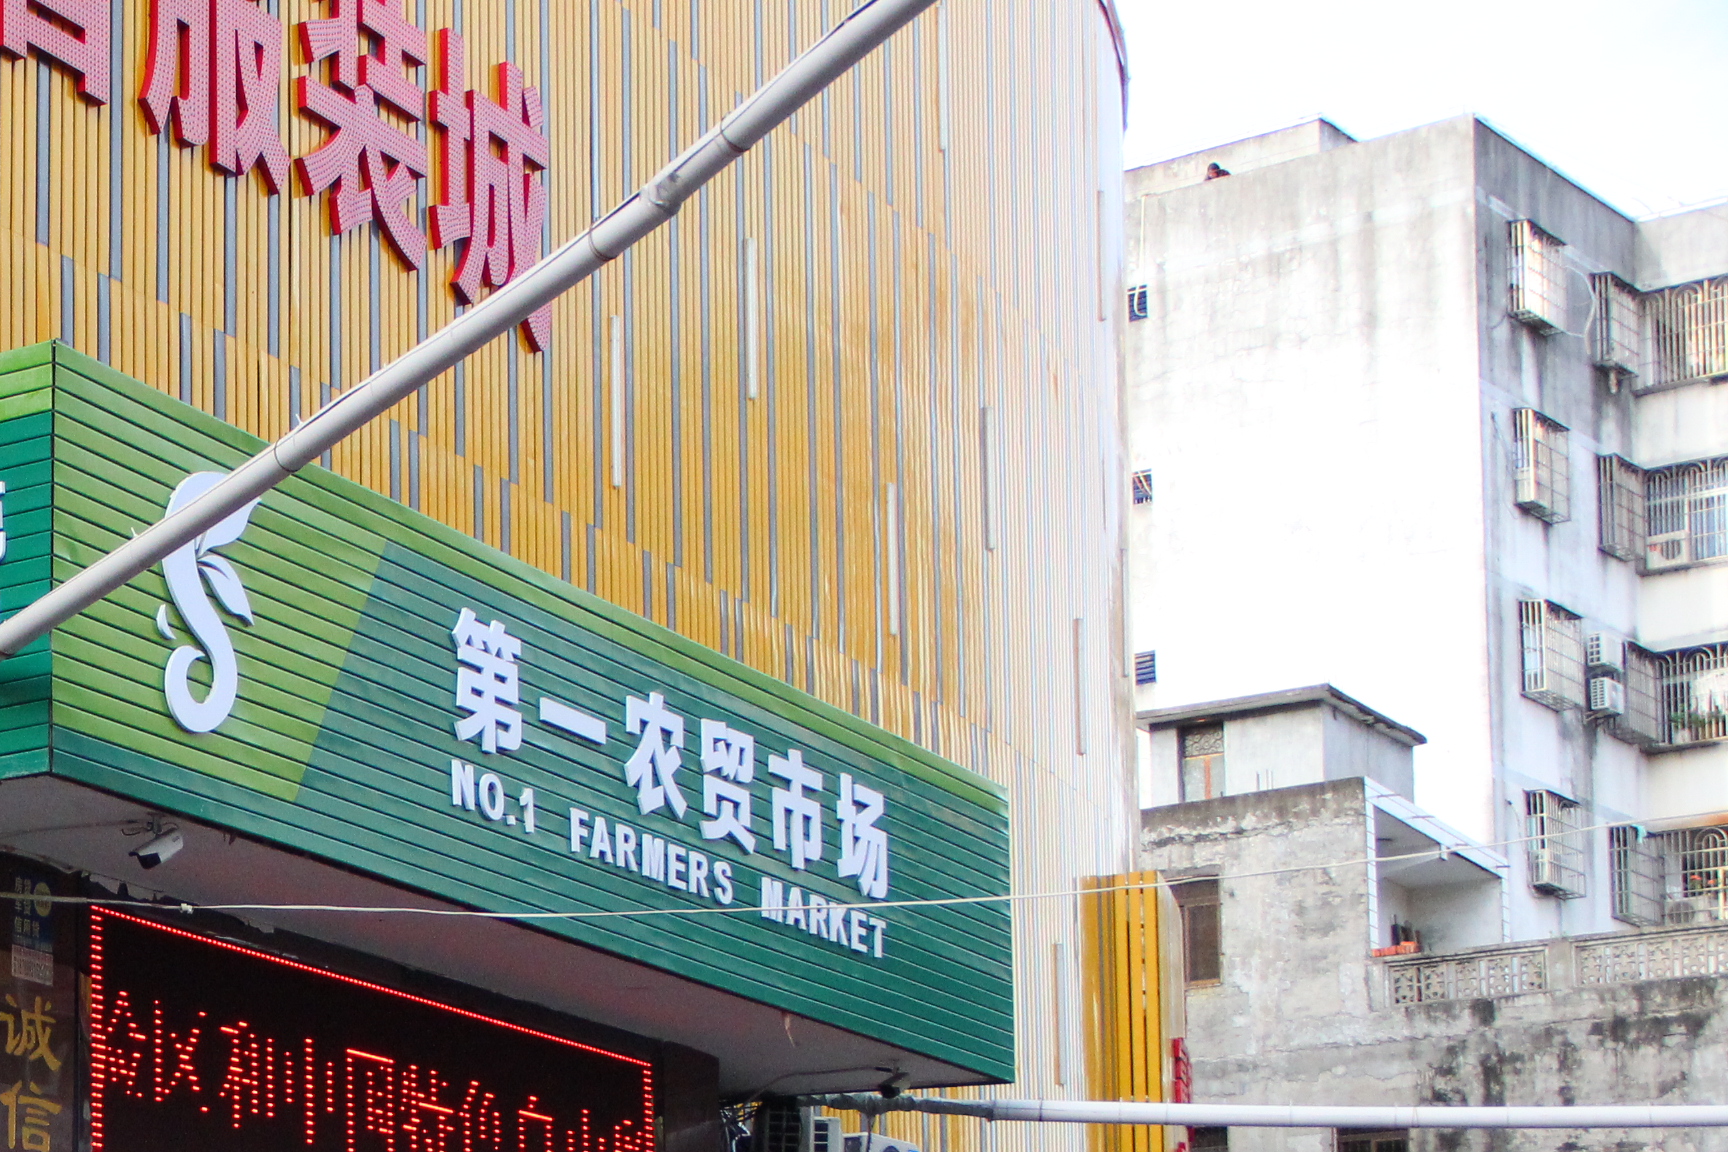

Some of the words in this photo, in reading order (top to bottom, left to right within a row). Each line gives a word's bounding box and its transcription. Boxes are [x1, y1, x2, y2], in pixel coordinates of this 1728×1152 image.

[451, 606, 889, 900] 第一农贸市场
[451, 758, 536, 834] NO.1
[569, 806, 734, 906] FARMERS
[759, 876, 887, 960] MARKET
